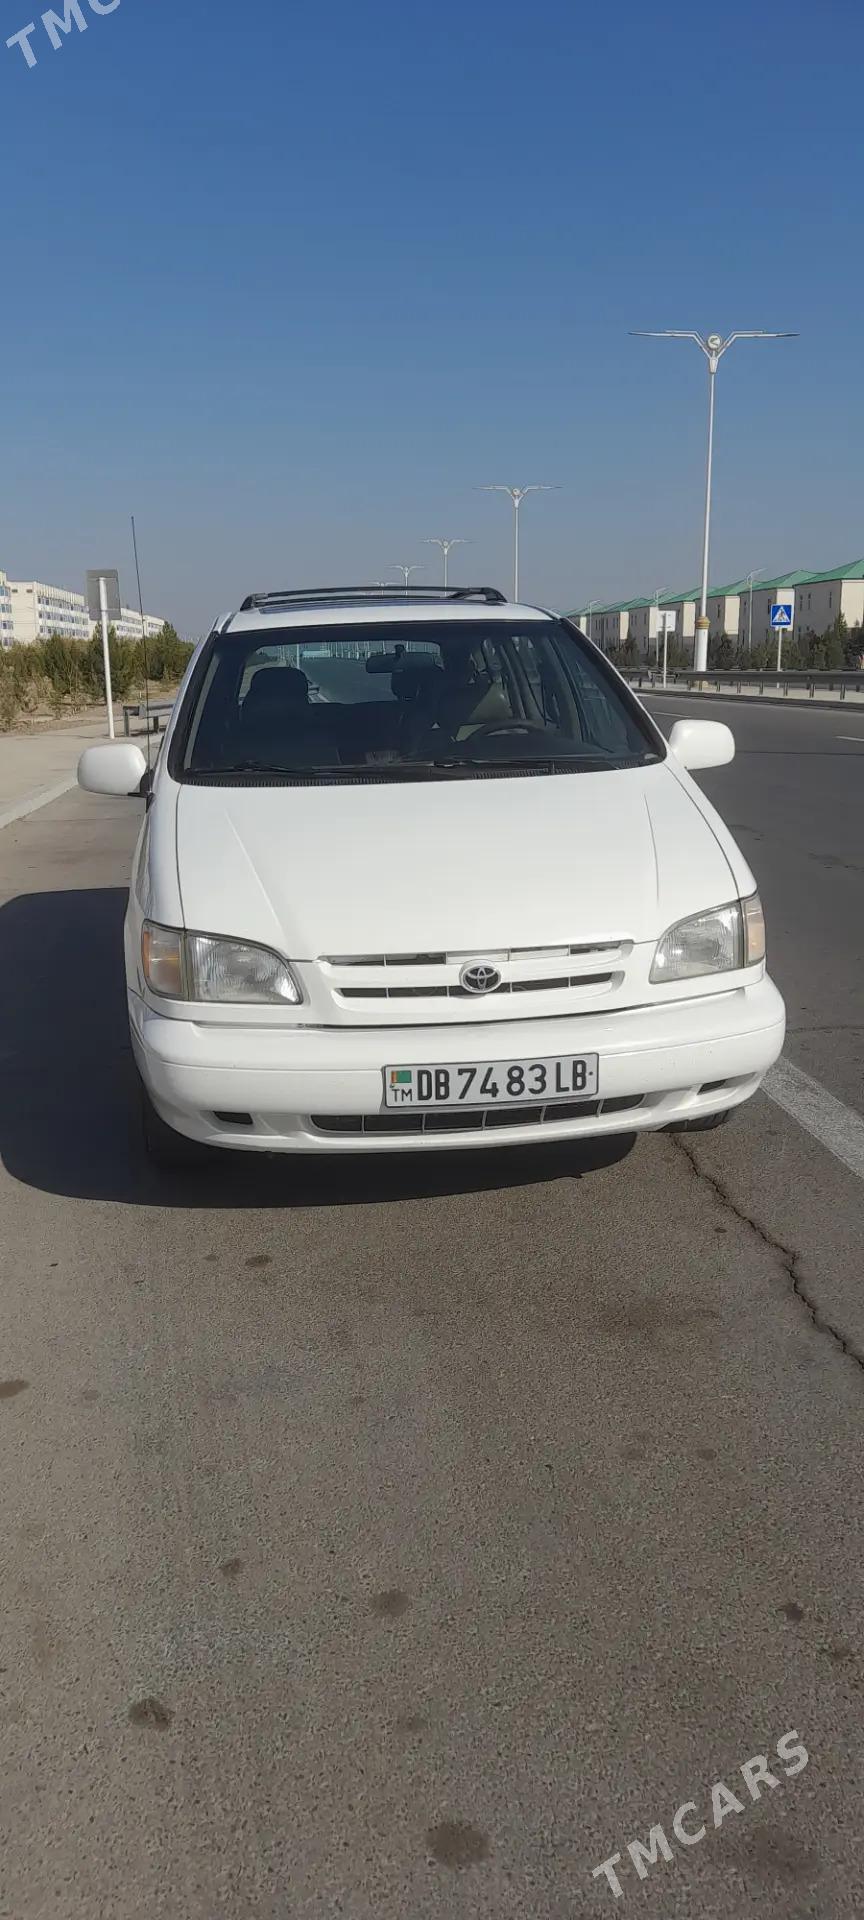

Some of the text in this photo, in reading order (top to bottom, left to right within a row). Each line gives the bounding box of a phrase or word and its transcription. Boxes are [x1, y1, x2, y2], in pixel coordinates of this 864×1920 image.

[417, 1069, 450, 1101] DB
[555, 1059, 587, 1092] LB
[391, 1088, 412, 1102] TM
